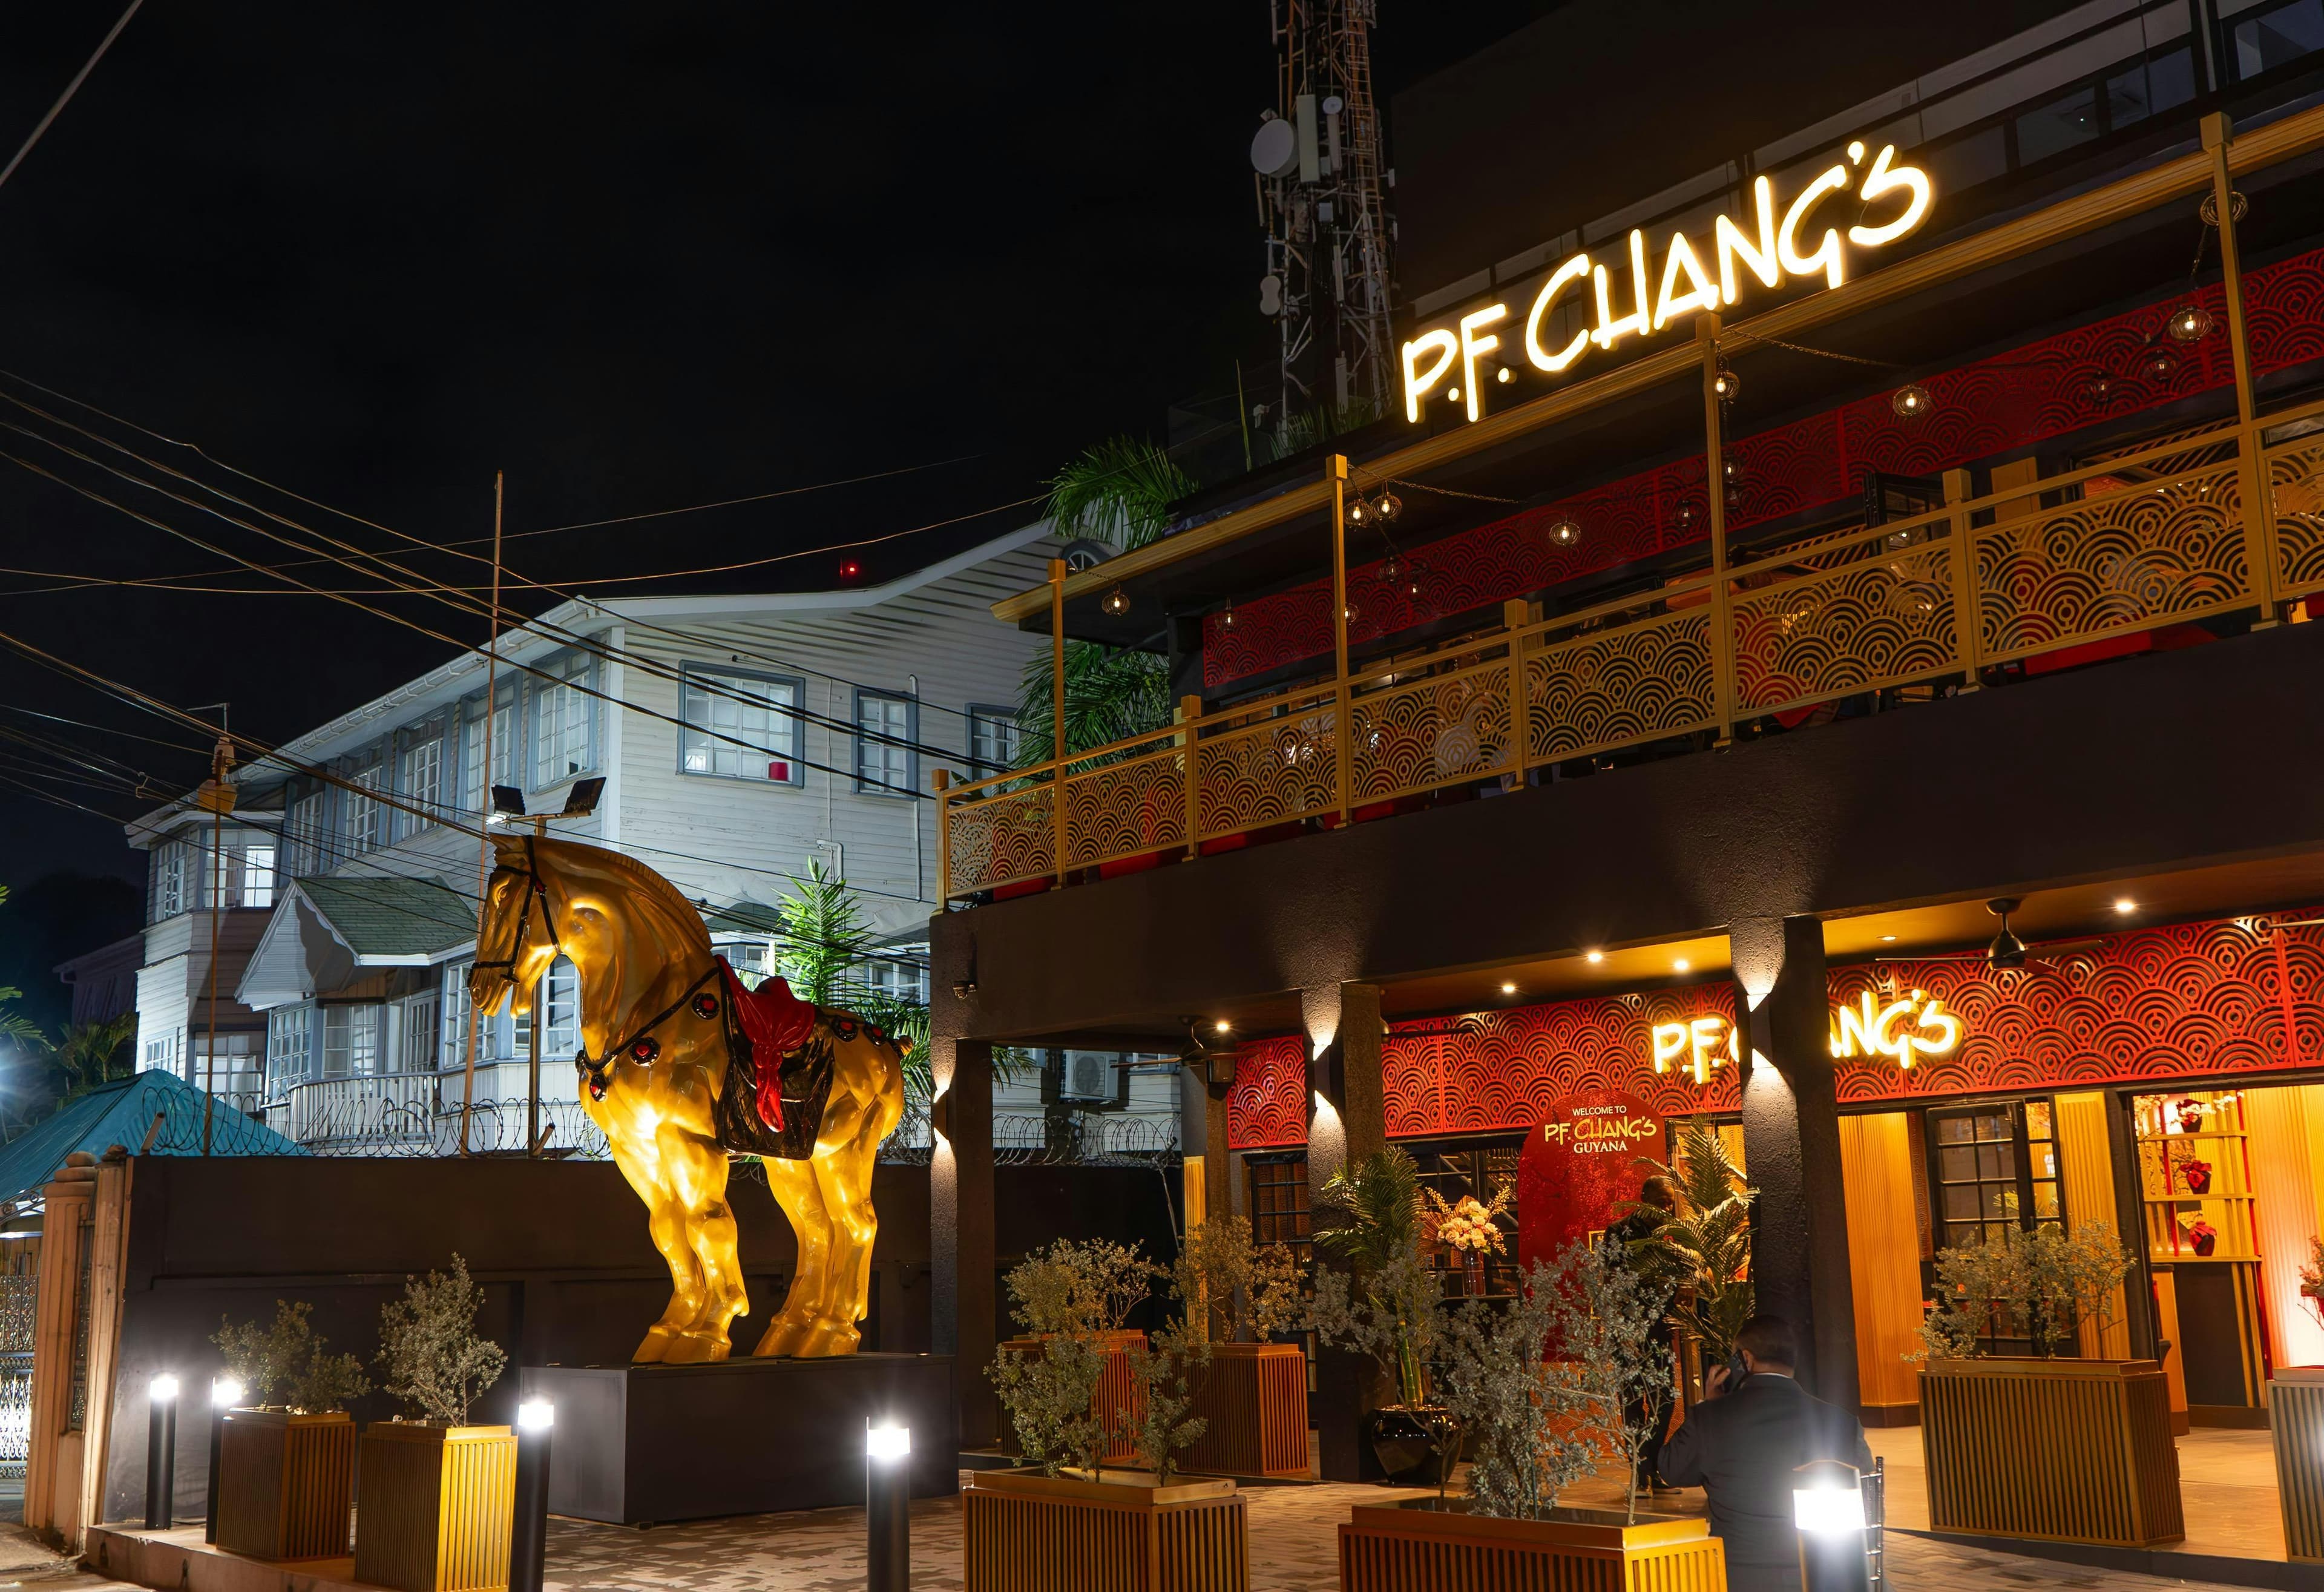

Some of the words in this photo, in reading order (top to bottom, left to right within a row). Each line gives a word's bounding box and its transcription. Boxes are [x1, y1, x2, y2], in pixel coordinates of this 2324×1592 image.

[1402, 303, 1511, 423] P.F.
[1525, 141, 1931, 372] CHANG'S
[1652, 1018, 1726, 1084] P.F.
[1572, 1107, 1613, 1116] WELCOME
[1614, 1105, 1627, 1114] TO
[1544, 1122, 1571, 1145] P.F.
[1574, 1116, 1657, 1142] CHANG'S
[1573, 1140, 1628, 1154] GUYANA
